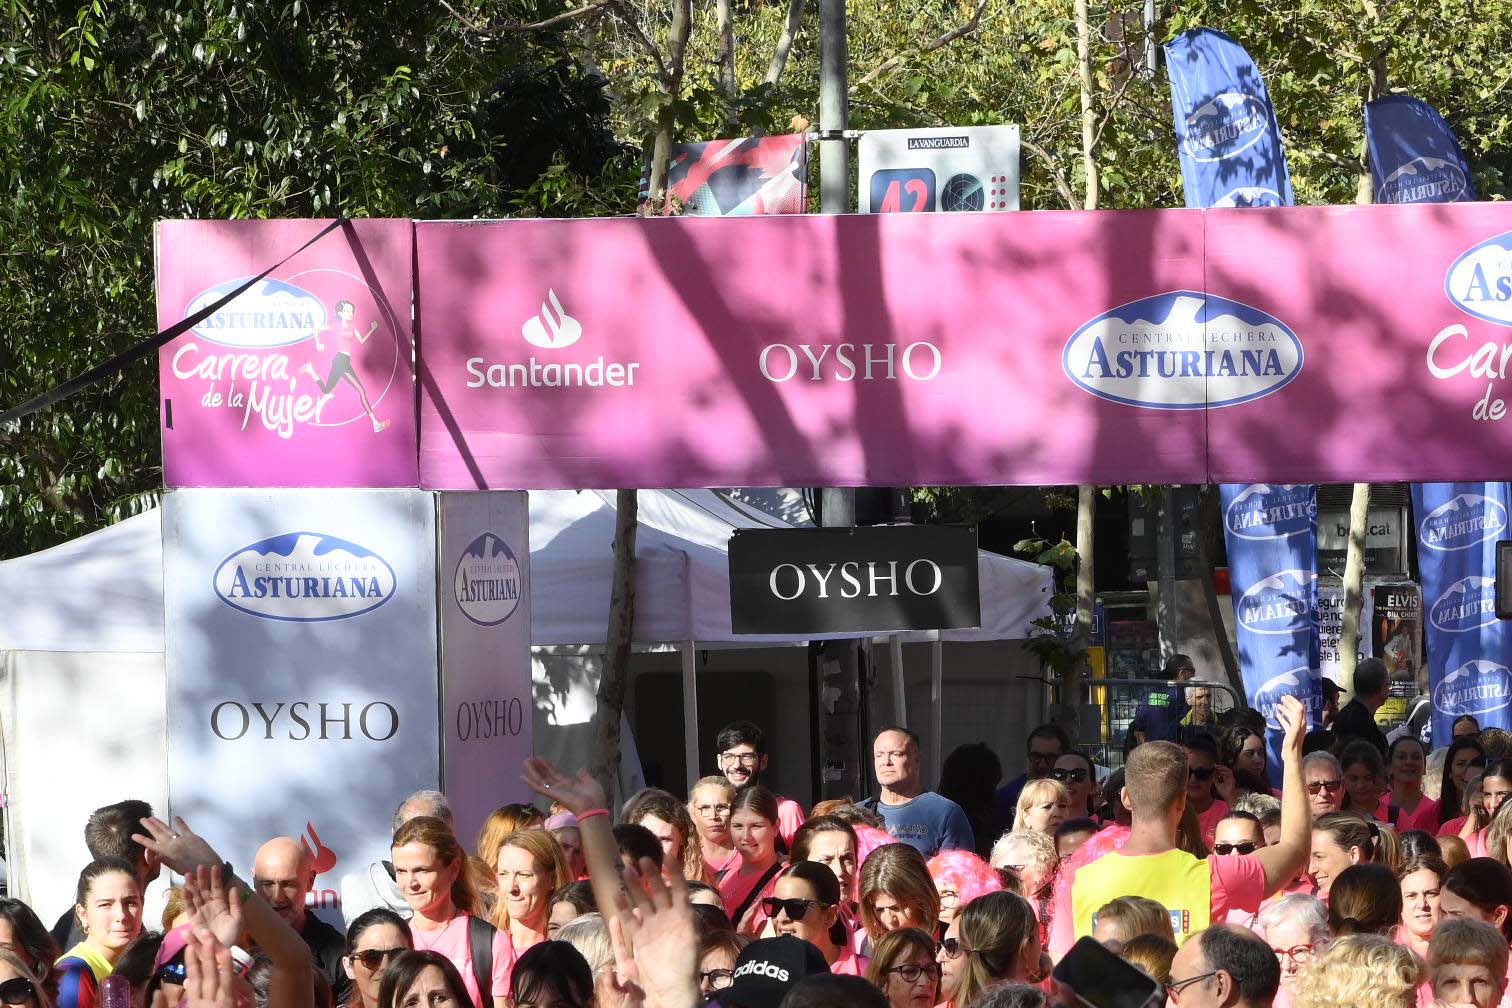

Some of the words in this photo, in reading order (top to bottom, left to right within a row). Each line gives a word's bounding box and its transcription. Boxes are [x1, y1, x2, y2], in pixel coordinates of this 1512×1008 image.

[919, 137, 968, 148] VANGUARDIA
[172, 343, 291, 381] Carrera
[466, 355, 640, 389] Santander
[758, 341, 943, 382] OYSHO
[1082, 336, 1285, 378] ASTURIANA
[201, 381, 224, 408] de
[227, 379, 244, 409] la
[241, 377, 335, 440] Mujer
[1472, 382, 1507, 422] de
[228, 565, 383, 599] ASTURIANA
[254, 563, 313, 573] CENTRAL
[460, 567, 518, 602] ASTURIANA
[769, 559, 942, 600] OYSHO
[1388, 595, 1418, 607] ELVIS
[210, 701, 399, 742] OYSHO
[456, 697, 523, 742] OYSHO
[734, 960, 789, 982] adidas
